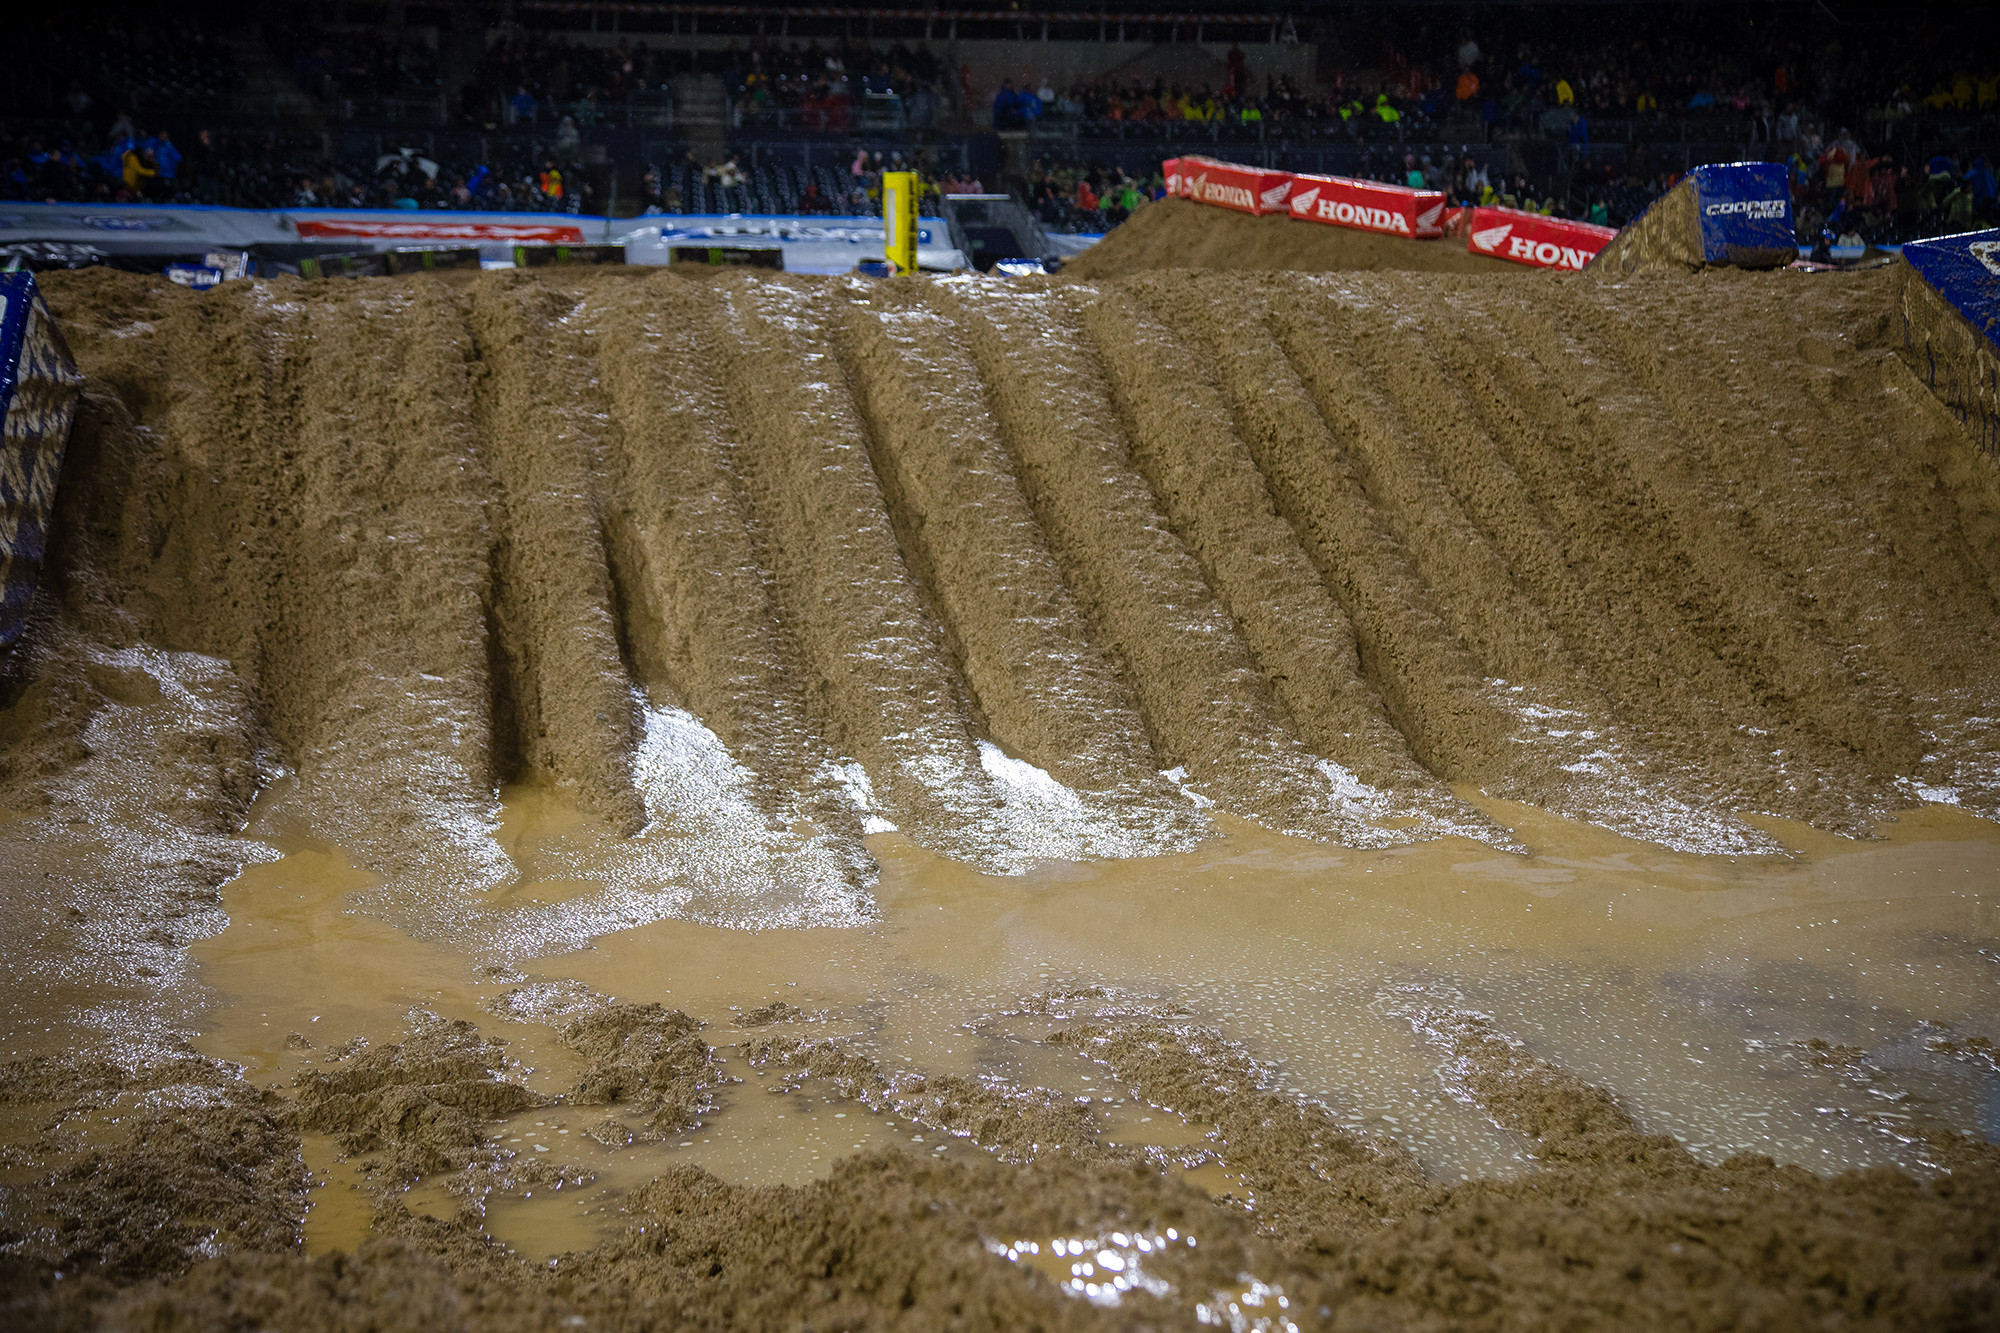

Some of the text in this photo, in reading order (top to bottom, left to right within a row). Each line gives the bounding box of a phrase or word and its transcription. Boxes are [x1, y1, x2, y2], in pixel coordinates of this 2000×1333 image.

[1205, 182, 1255, 209] HONDA
[1706, 200, 1786, 216] COOPER
[1317, 198, 1411, 233] HONDA
[1508, 236, 1597, 270] HON
